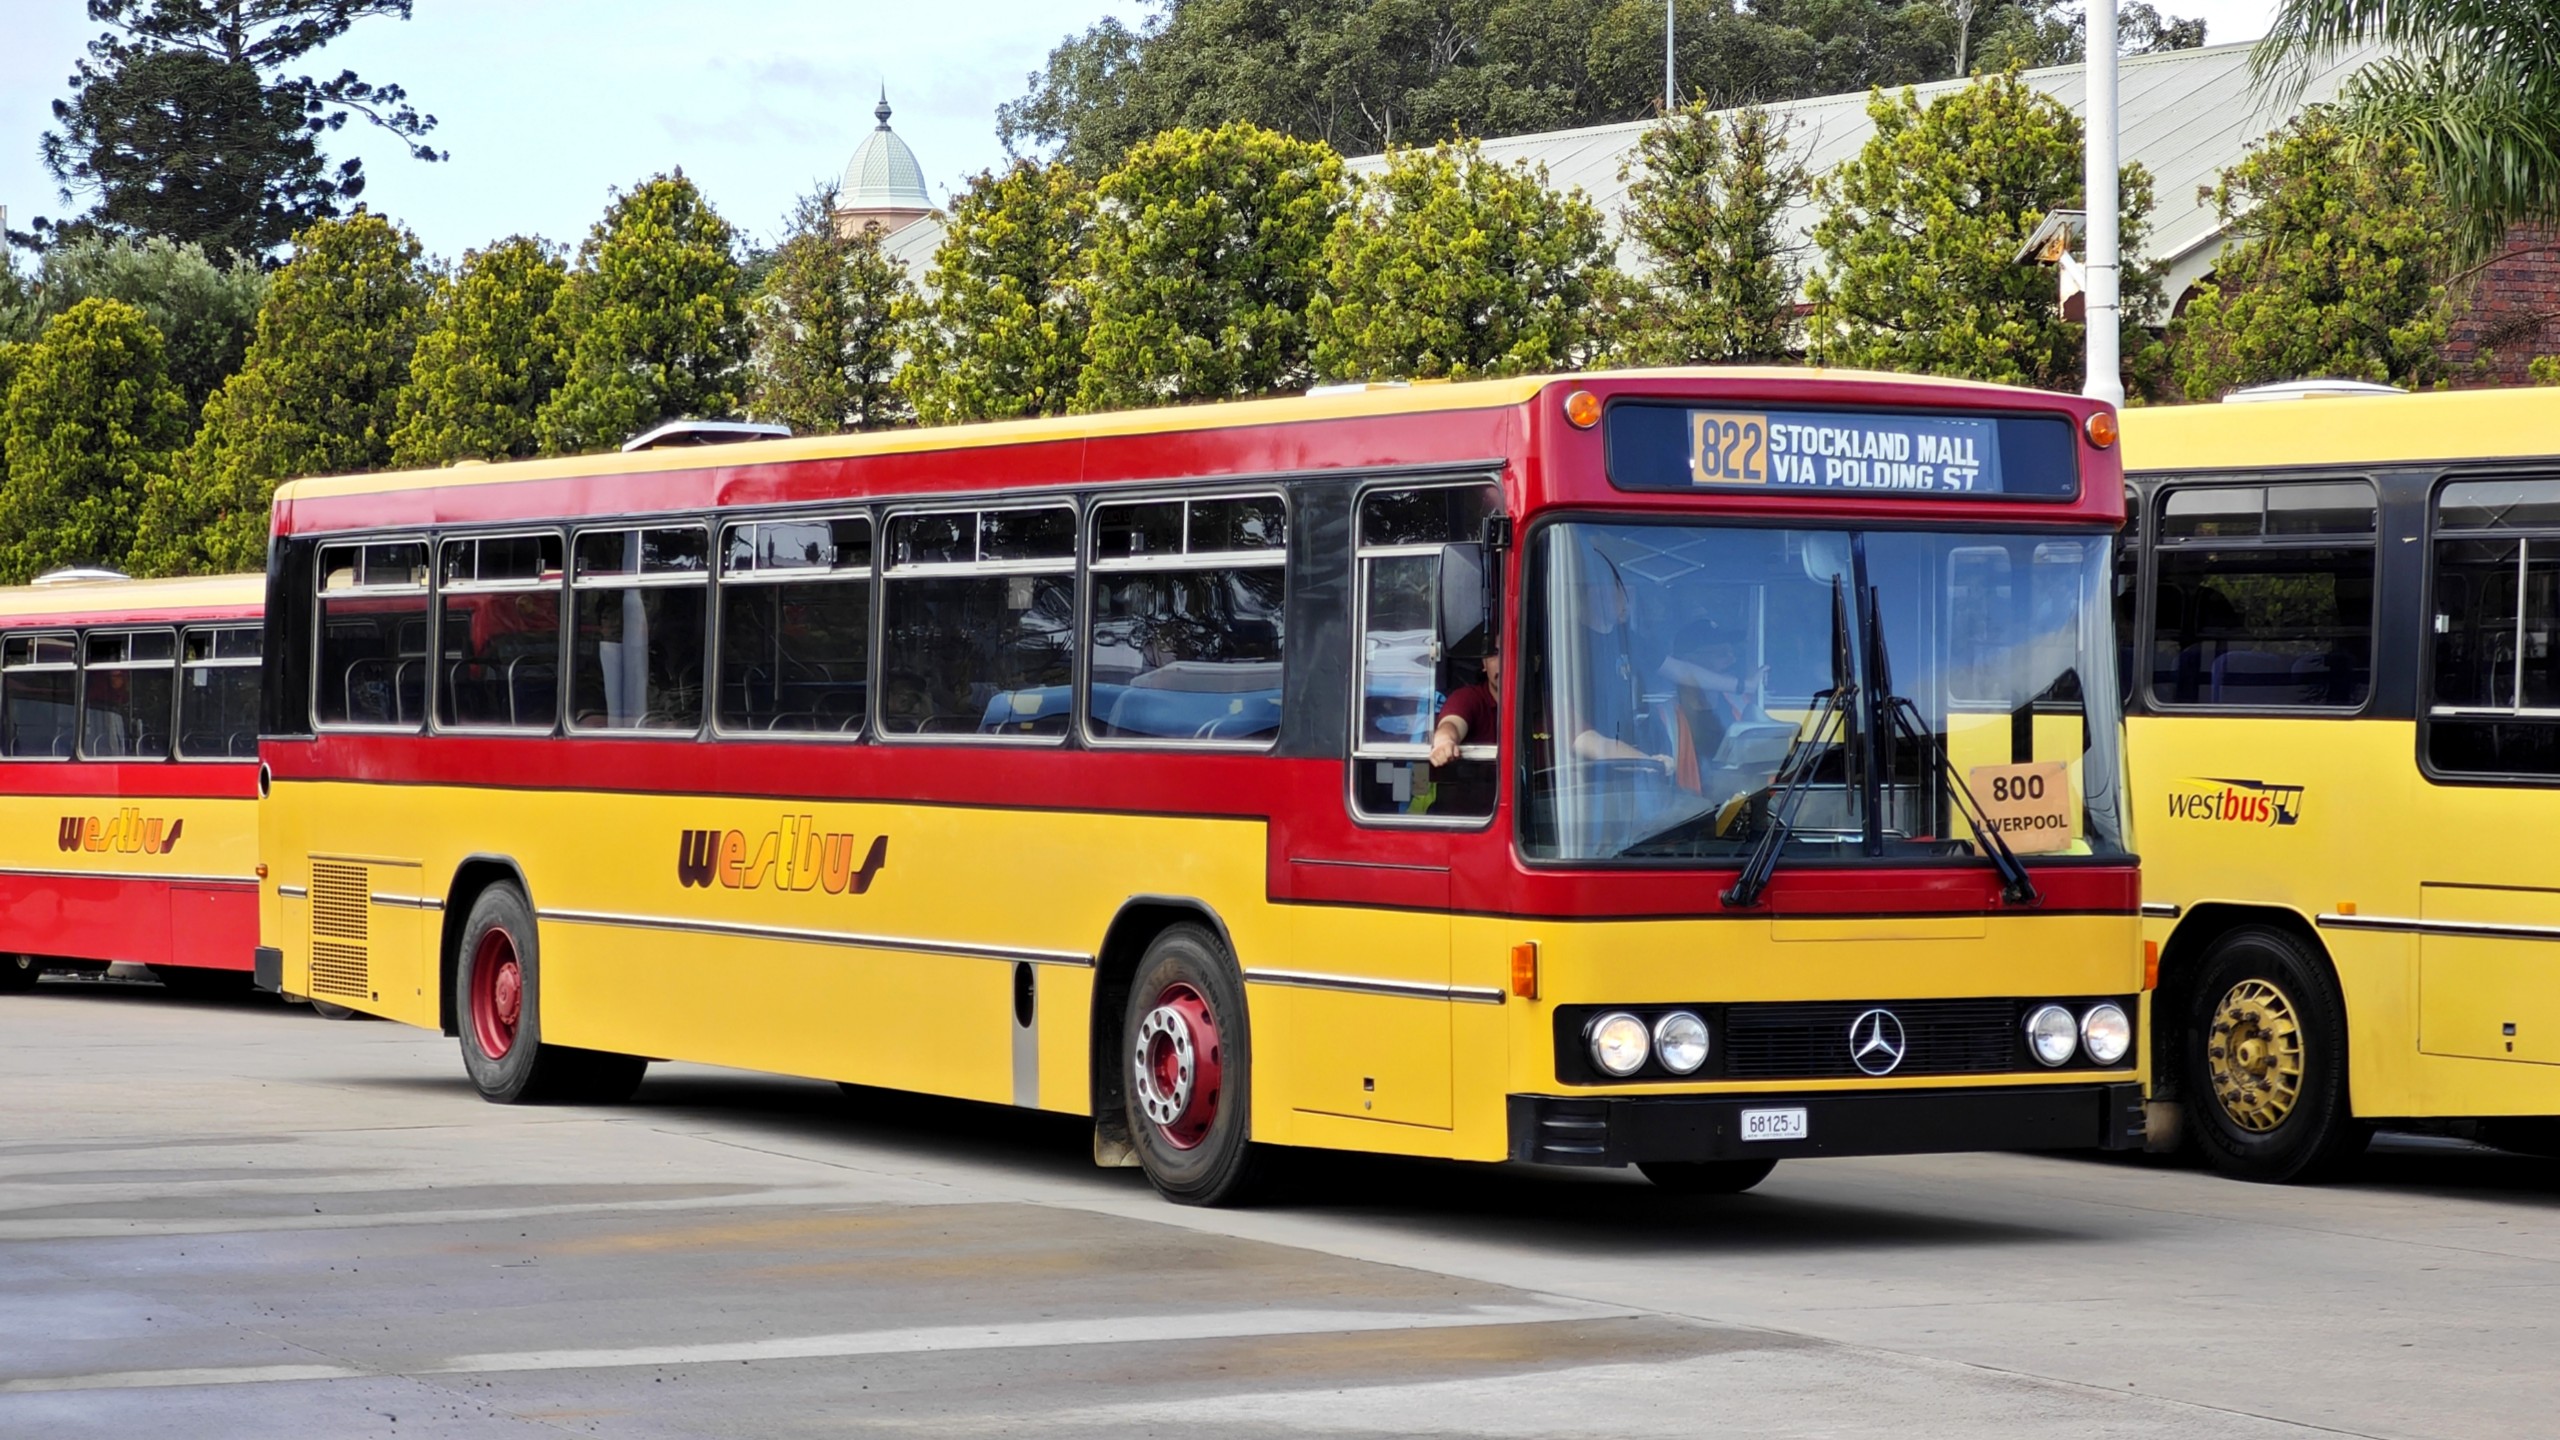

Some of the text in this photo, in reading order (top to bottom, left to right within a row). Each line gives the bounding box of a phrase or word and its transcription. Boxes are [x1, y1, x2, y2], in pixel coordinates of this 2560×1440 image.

[1702, 419, 1762, 480] 822
[1769, 423, 1980, 467] STOCKLAND MALL
[1772, 454, 1979, 491] VIA POLDING ST
[1992, 774, 2045, 802] 800
[2168, 787, 2271, 823] westbus
[1976, 813, 2068, 834] LVERPOOL
